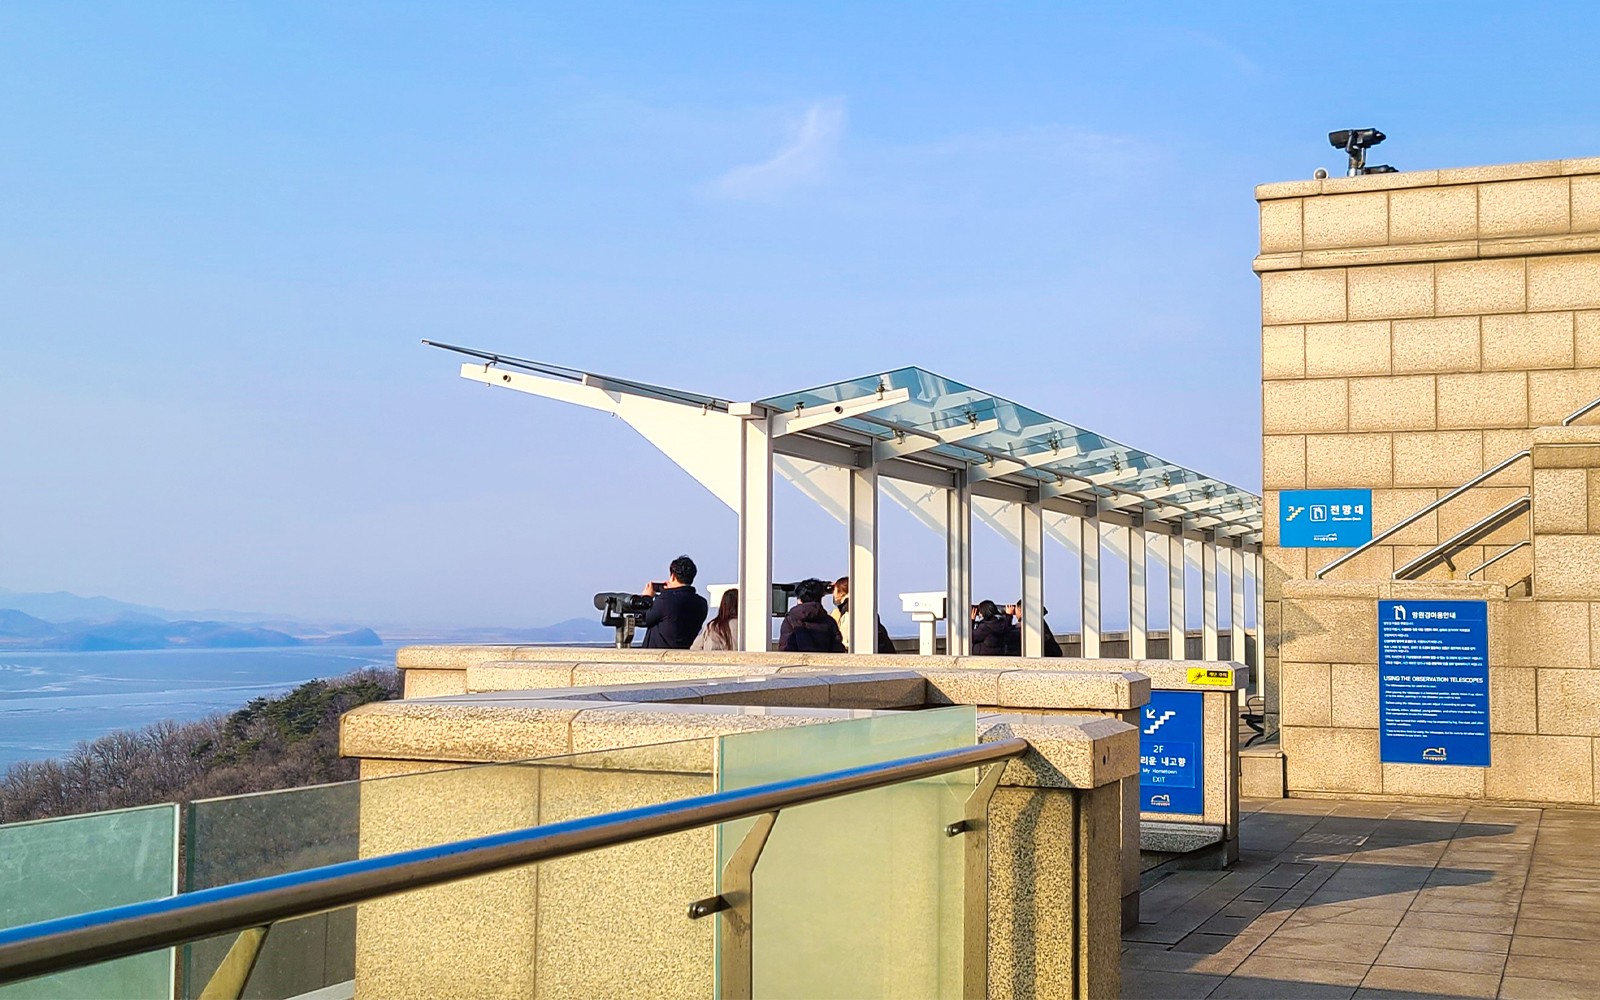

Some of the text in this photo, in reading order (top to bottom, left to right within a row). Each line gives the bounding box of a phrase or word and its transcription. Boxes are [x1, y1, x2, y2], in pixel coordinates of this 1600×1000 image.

[1330, 504, 1364, 515] 전망대
[1153, 744, 1164, 753] 2F
[1140, 756, 1186, 767] 리운 내고향
